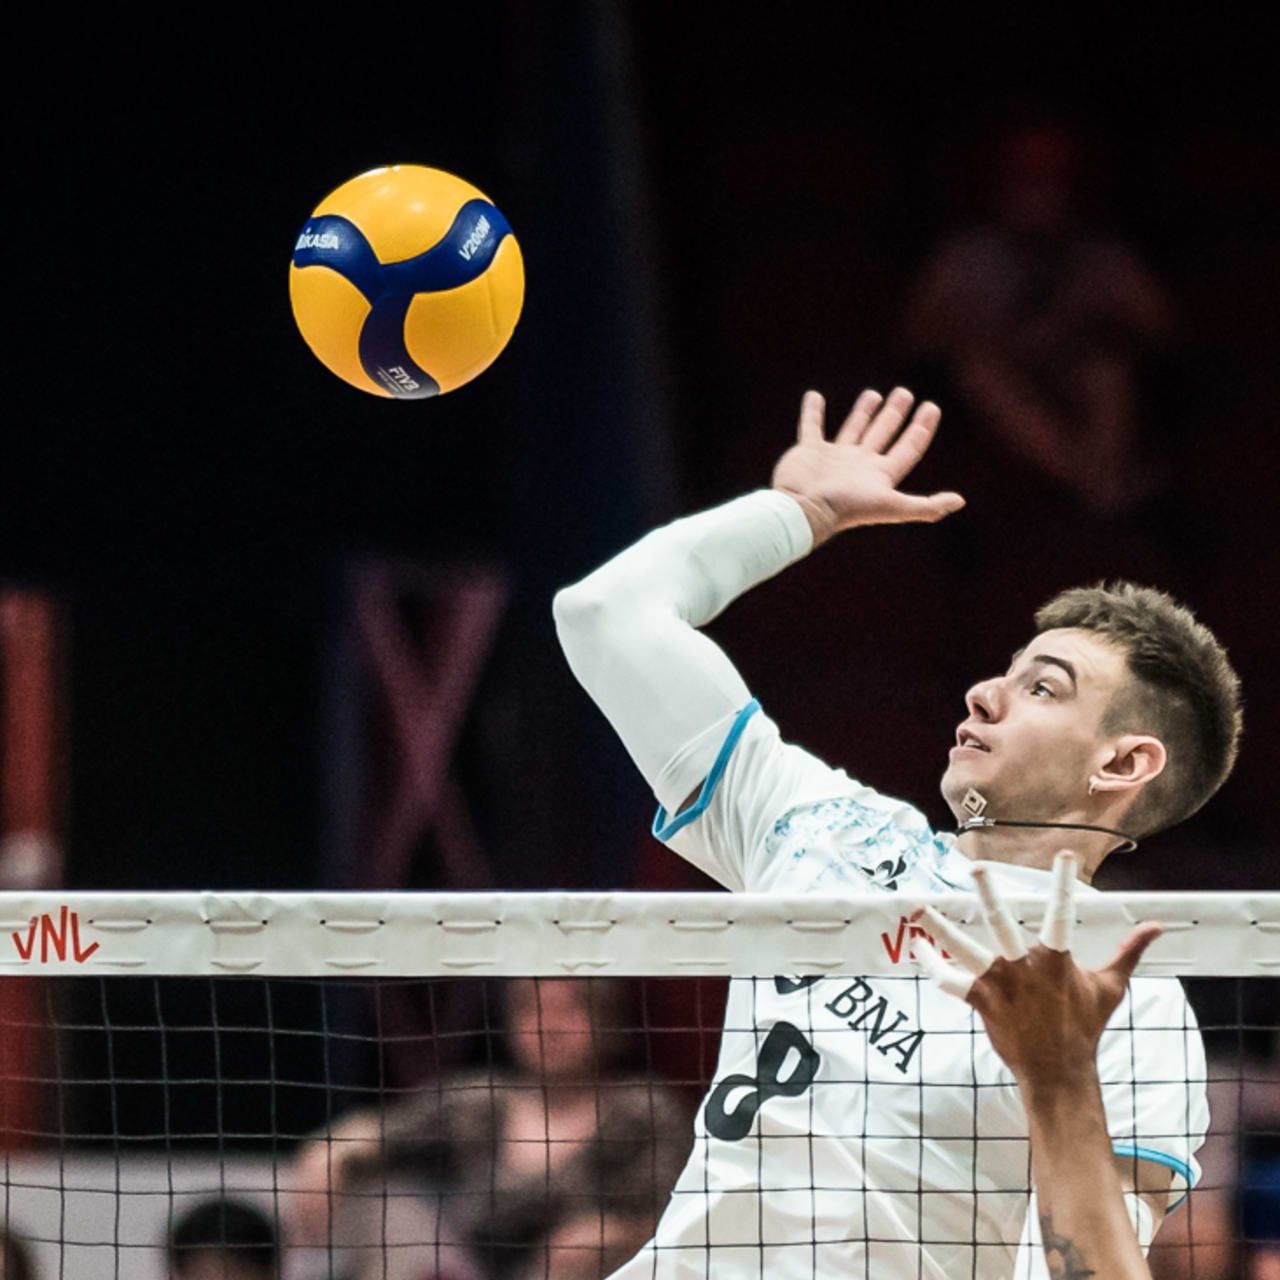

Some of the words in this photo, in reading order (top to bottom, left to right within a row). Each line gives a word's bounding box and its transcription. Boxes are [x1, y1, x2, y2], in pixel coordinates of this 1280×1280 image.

[11, 905, 100, 963] VNL
[825, 976, 926, 1075] BNA
[704, 1020, 821, 1142] 8
